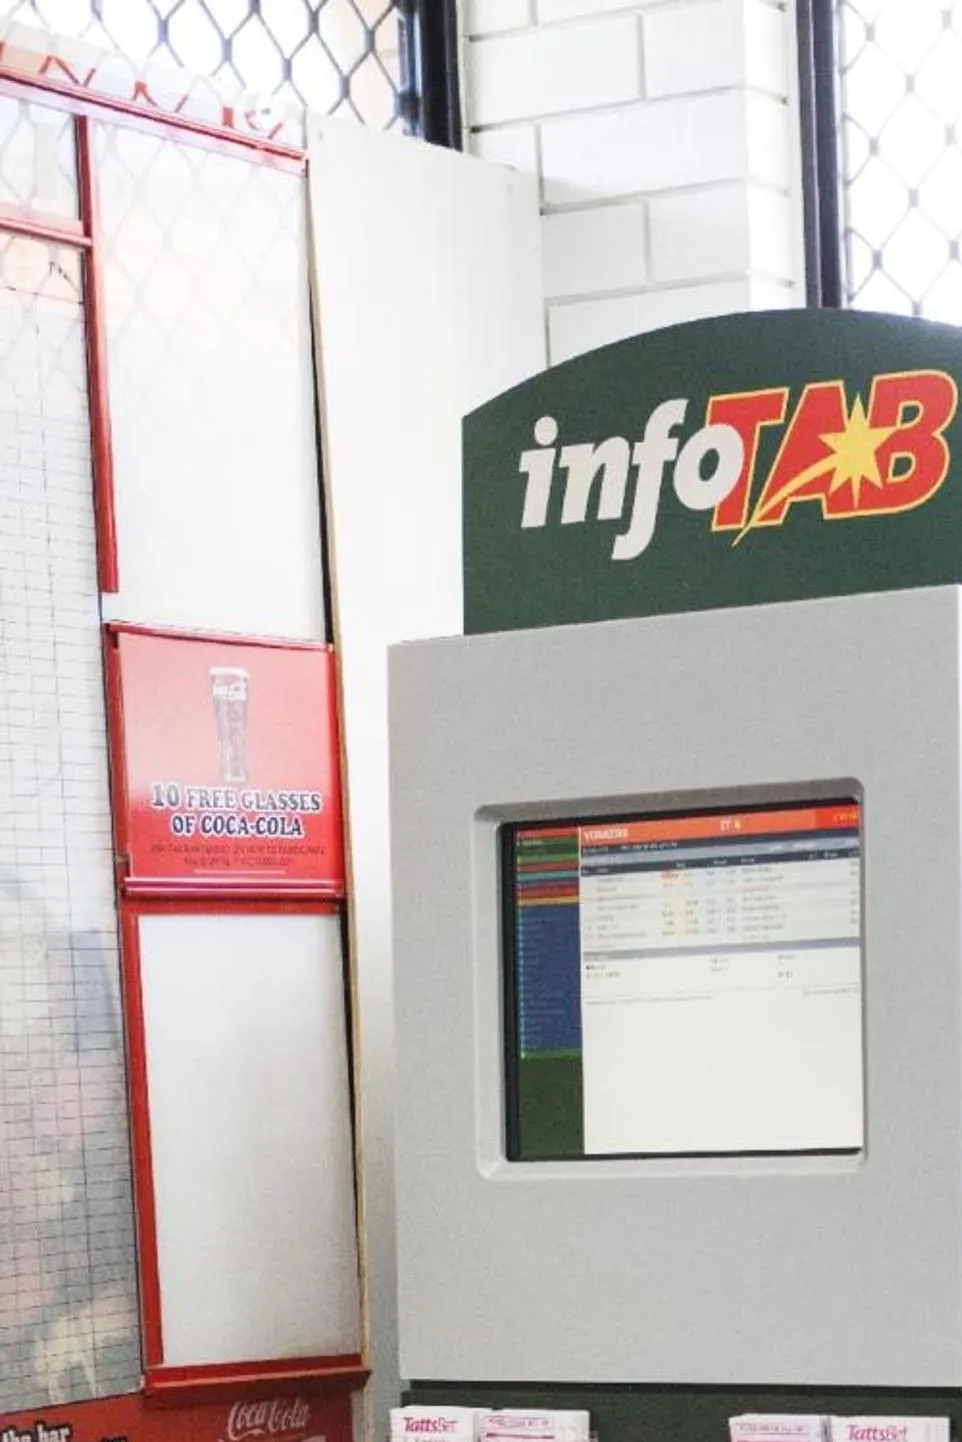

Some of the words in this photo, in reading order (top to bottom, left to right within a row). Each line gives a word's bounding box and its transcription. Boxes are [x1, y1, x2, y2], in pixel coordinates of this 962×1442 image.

[519, 369, 958, 561] infoTAB
[151, 783, 181, 808] 10
[186, 787, 235, 810] FREE
[241, 791, 322, 813] GLASSES
[172, 814, 196, 835] OF
[200, 815, 304, 837] COCA-COLA
